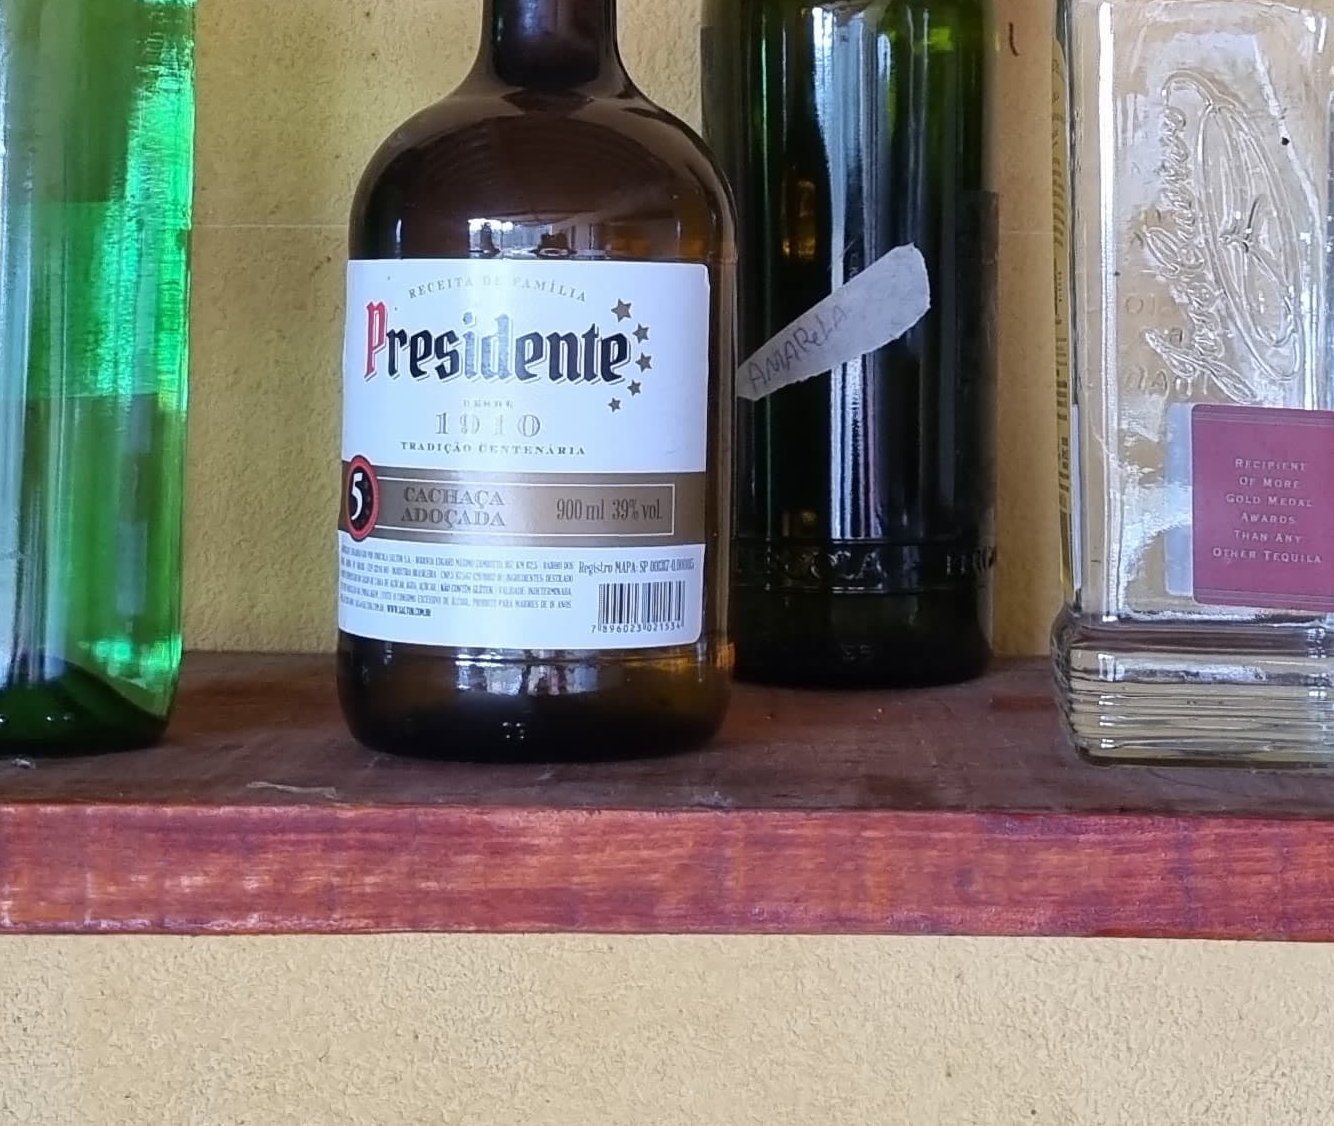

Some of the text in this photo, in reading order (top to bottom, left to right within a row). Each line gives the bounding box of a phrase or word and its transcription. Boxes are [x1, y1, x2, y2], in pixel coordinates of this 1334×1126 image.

[408, 276, 474, 299] RECEITA
[512, 276, 588, 302] FAMÍLIA
[364, 300, 631, 383] Presidente
[435, 411, 542, 438] 1910
[400, 441, 586, 456] TRADIÇÃO CENTENÁRIA
[1235, 457, 1308, 473] RECIPIENT
[1261, 476, 1301, 490] MORE
[350, 471, 365, 521] 5
[403, 486, 506, 510] CACHAÇA
[1225, 493, 1314, 508] GOLD MEDAL
[400, 507, 507, 528] ADOÇADA
[556, 499, 584, 521] 900
[586, 499, 605, 521] ml
[1240, 512, 1297, 526] AWARDS
[1233, 529, 1268, 543] THAN
[1212, 547, 1324, 565] OTHER TEQUILA
[578, 560, 613, 575] Registro
